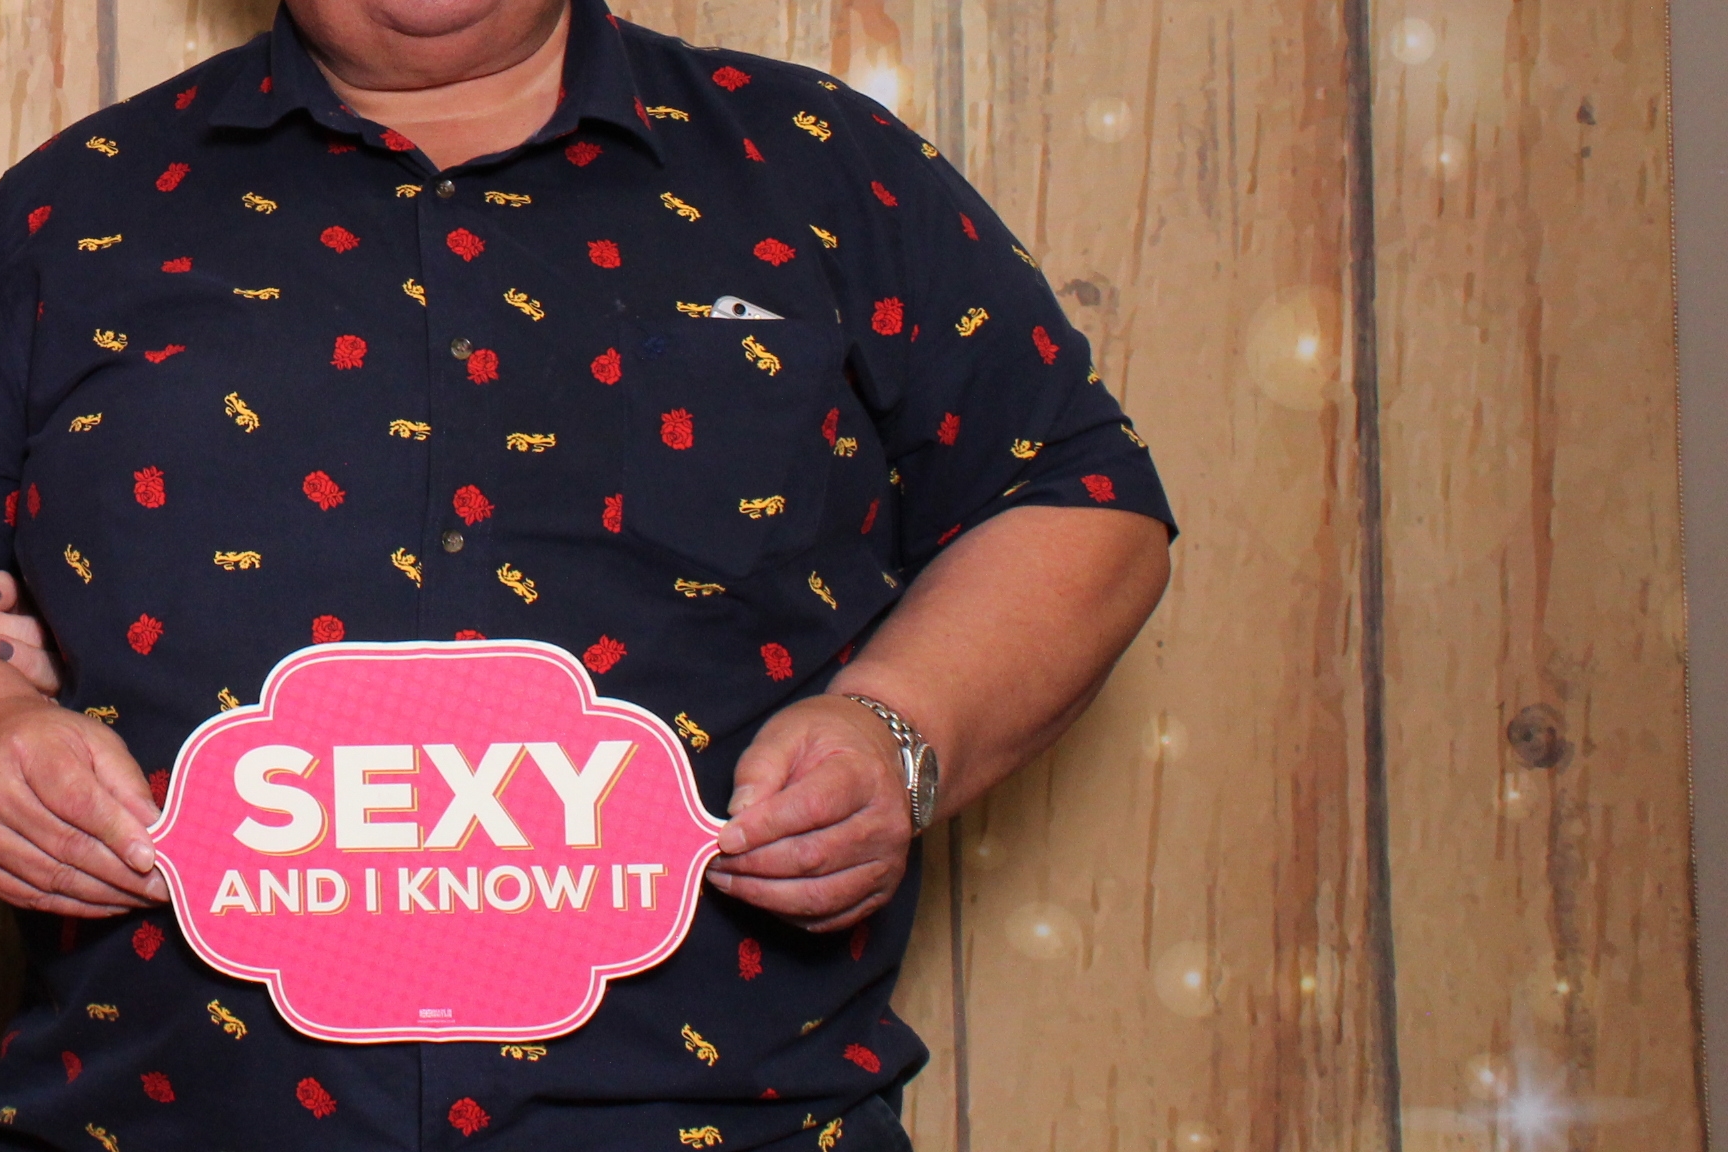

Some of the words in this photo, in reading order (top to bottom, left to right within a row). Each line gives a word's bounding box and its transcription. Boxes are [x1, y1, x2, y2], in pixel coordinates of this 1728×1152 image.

[232, 740, 639, 856] SEXY
[210, 868, 351, 916] AND
[365, 867, 382, 915] I
[398, 865, 599, 914] KNOW
[611, 863, 668, 912] IT
